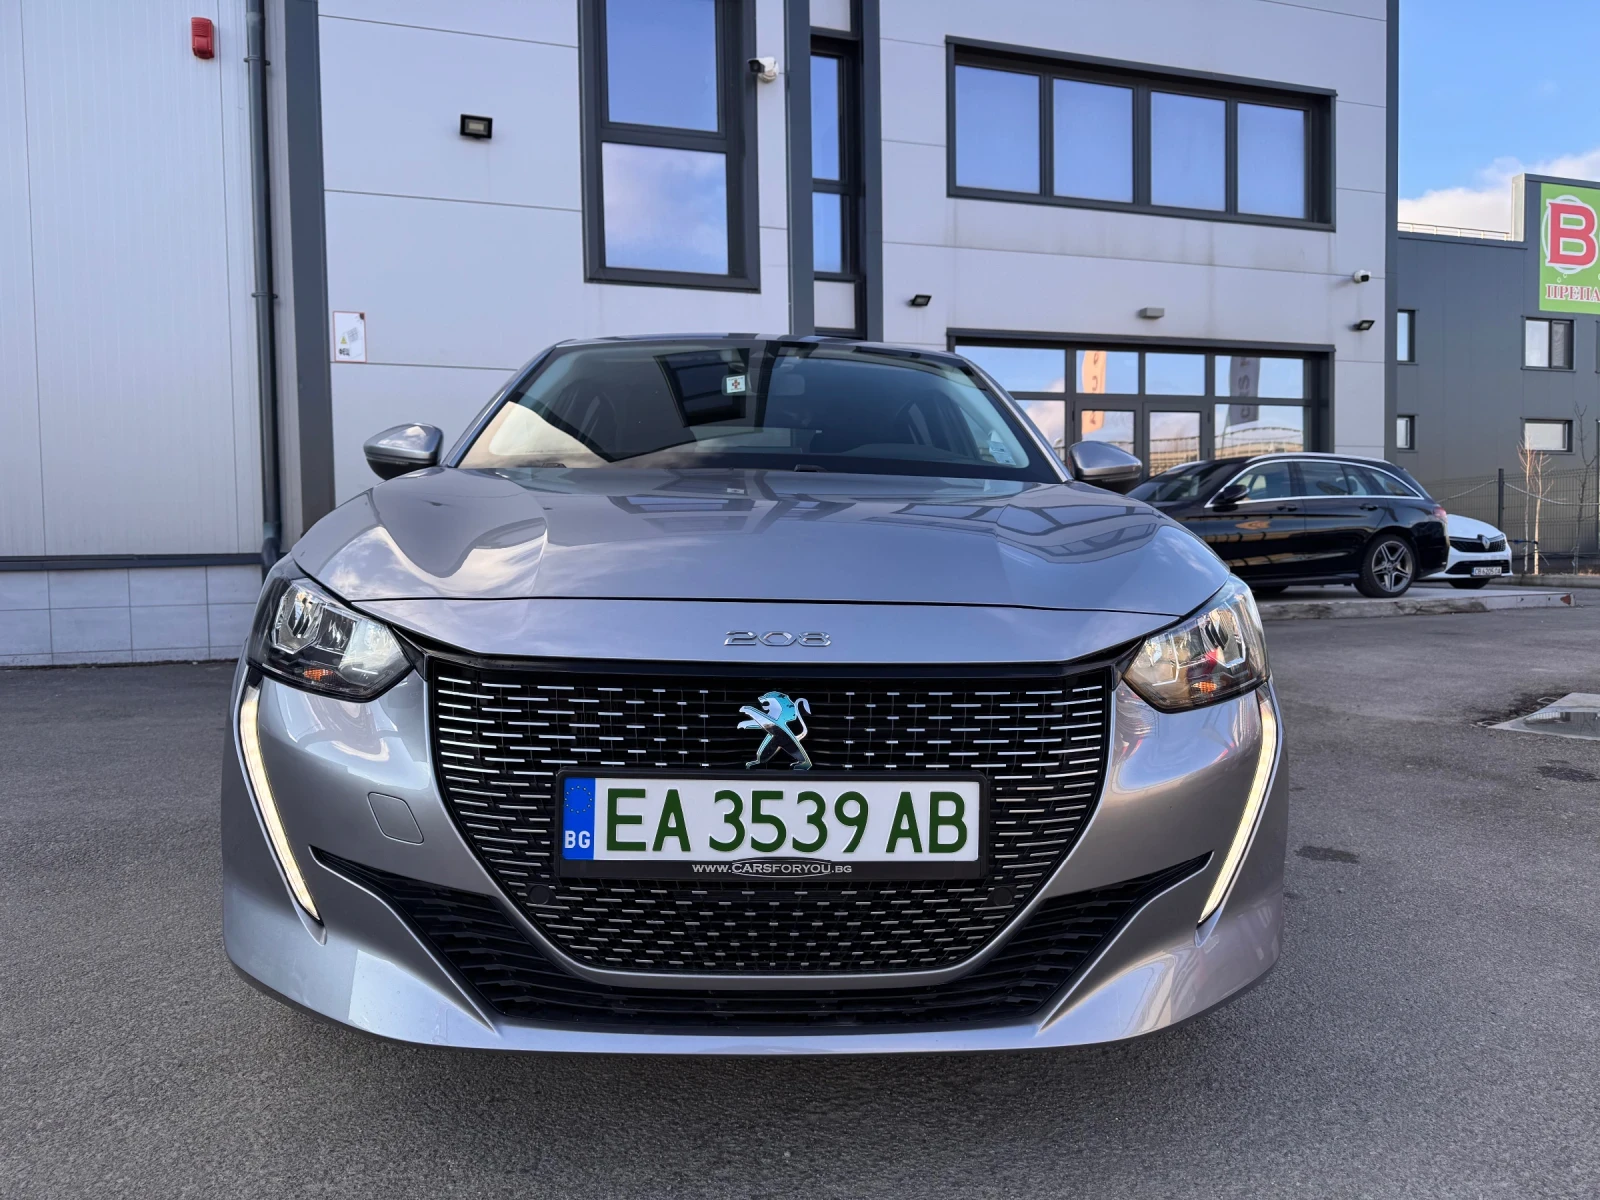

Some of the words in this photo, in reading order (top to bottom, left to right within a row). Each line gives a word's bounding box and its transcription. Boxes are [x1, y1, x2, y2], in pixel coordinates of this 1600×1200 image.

[724, 631, 832, 647] 208
[606, 788, 692, 852] EA
[709, 789, 869, 853] 3539
[885, 791, 968, 854] AB
[564, 830, 591, 849] BG
